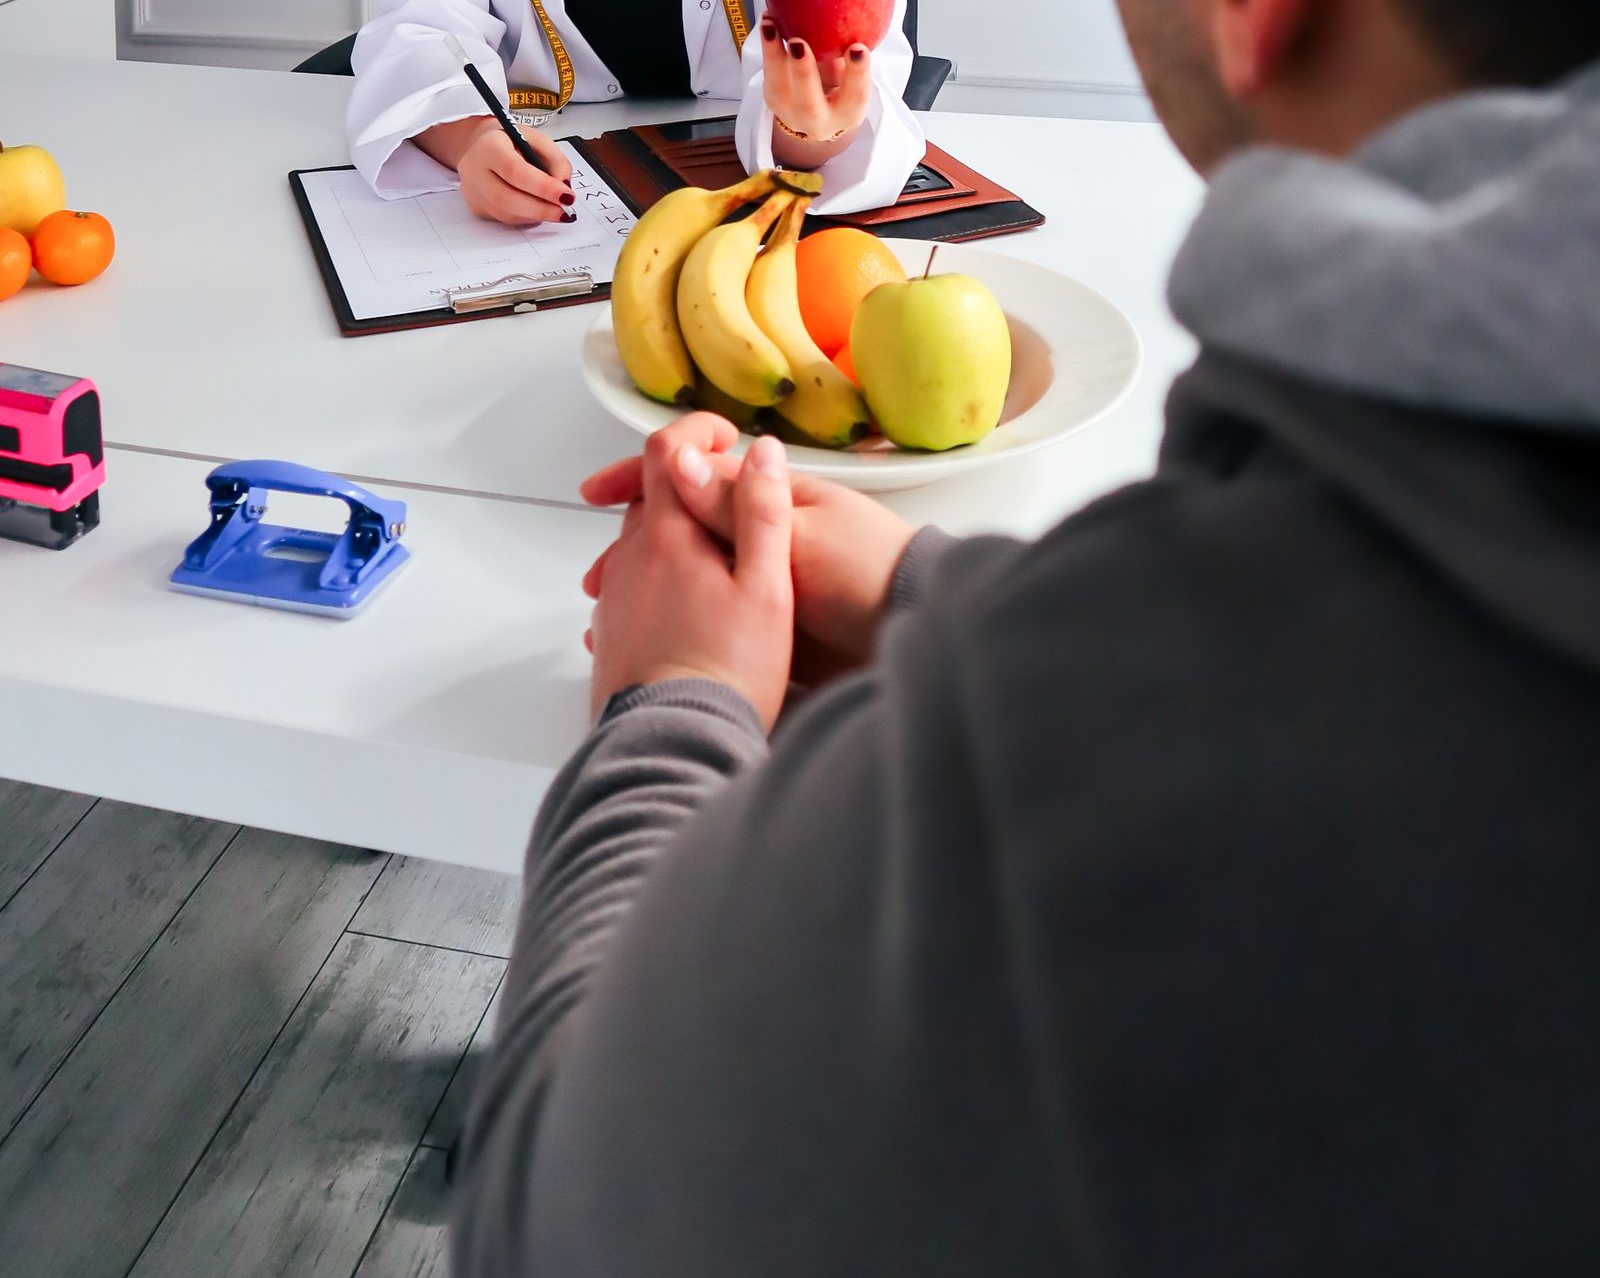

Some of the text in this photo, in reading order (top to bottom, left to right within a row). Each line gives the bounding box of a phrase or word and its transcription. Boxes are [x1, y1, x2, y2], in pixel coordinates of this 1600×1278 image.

[576, 181, 593, 190] T
[586, 191, 609, 201] W
[597, 203, 614, 211] T
[605, 213, 629, 224] M
[533, 265, 592, 278] WEEKL
